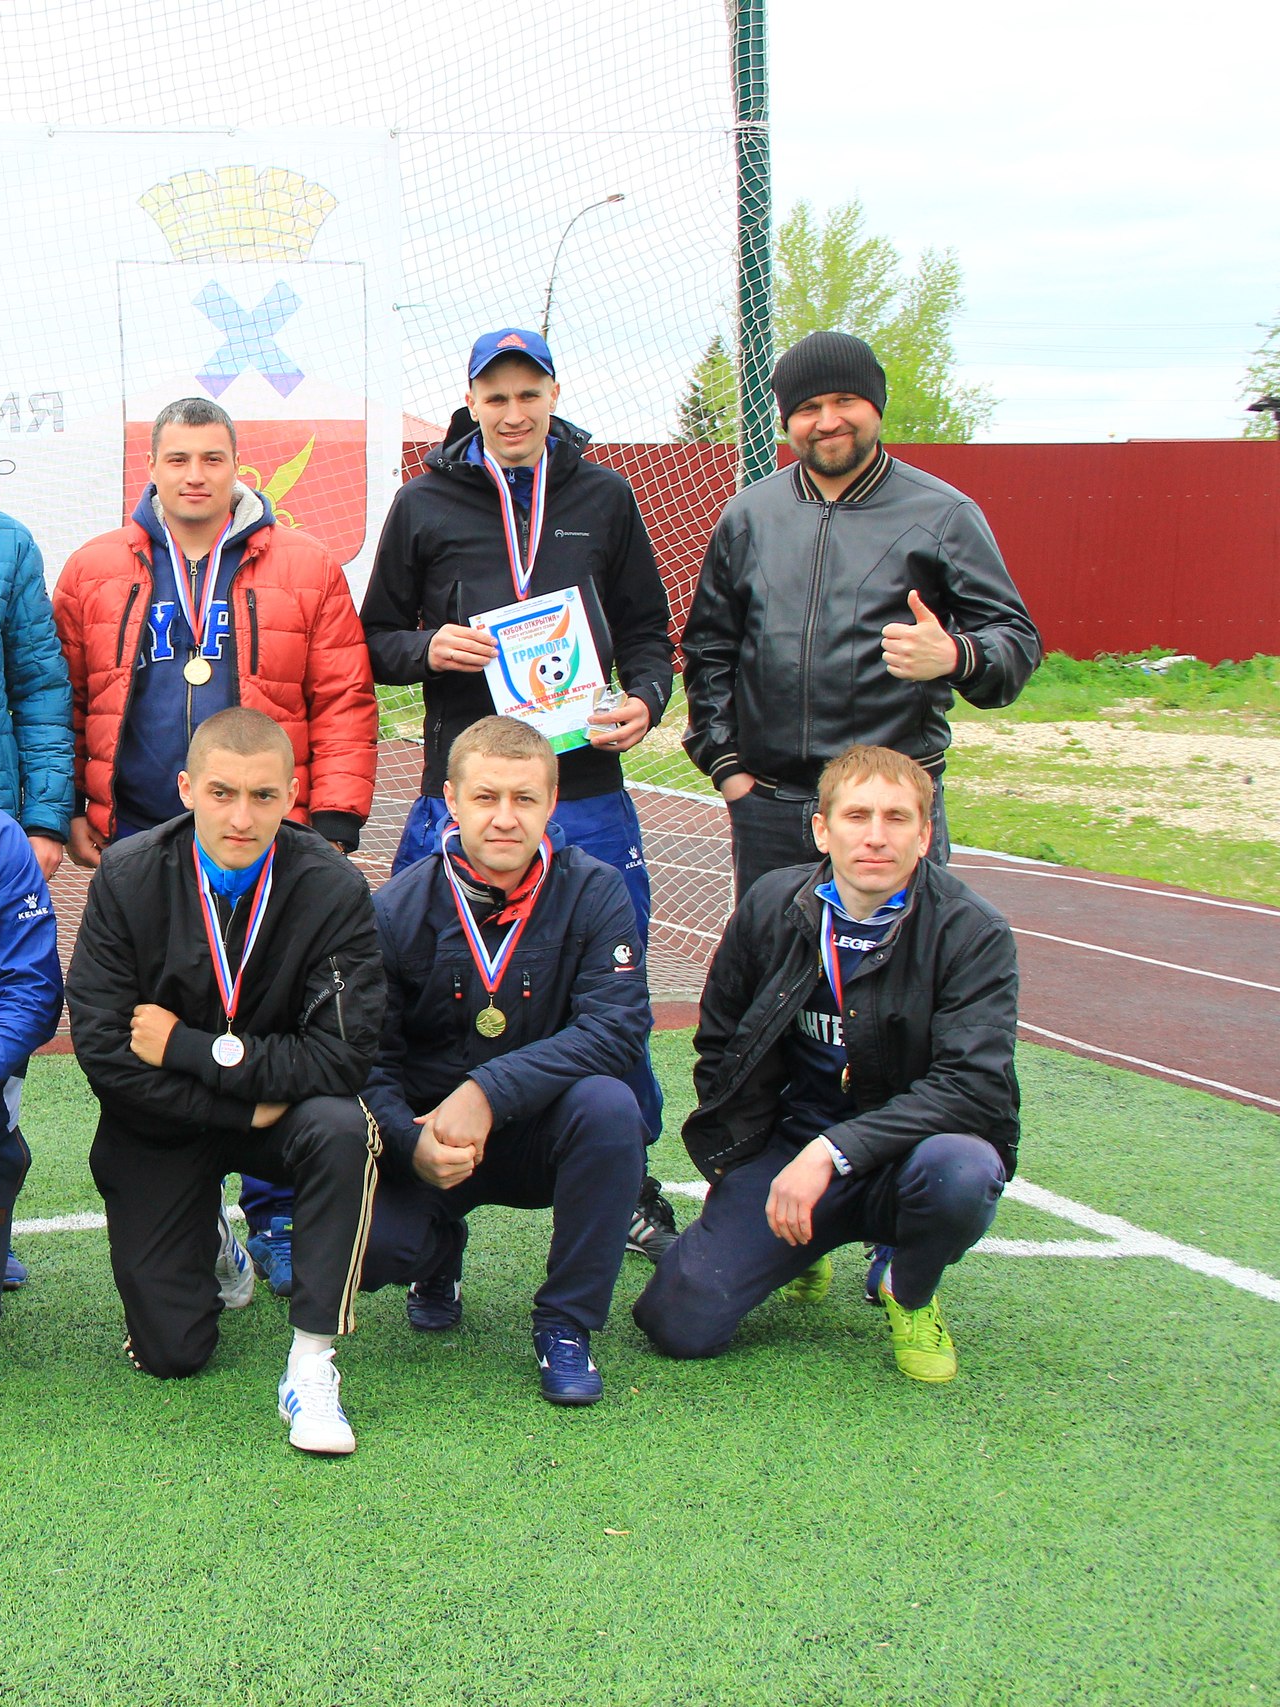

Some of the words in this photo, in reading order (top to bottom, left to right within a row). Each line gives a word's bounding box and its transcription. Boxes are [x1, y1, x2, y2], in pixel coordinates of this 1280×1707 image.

[512, 637, 571, 664] ГРАМОТА
[504, 699, 534, 714] САМЫЙ
[571, 681, 597, 693] ИГРОК
[18, 907, 49, 920] KELME
[832, 933, 877, 952] LEGE
[796, 1008, 846, 1047] АНТЕ
